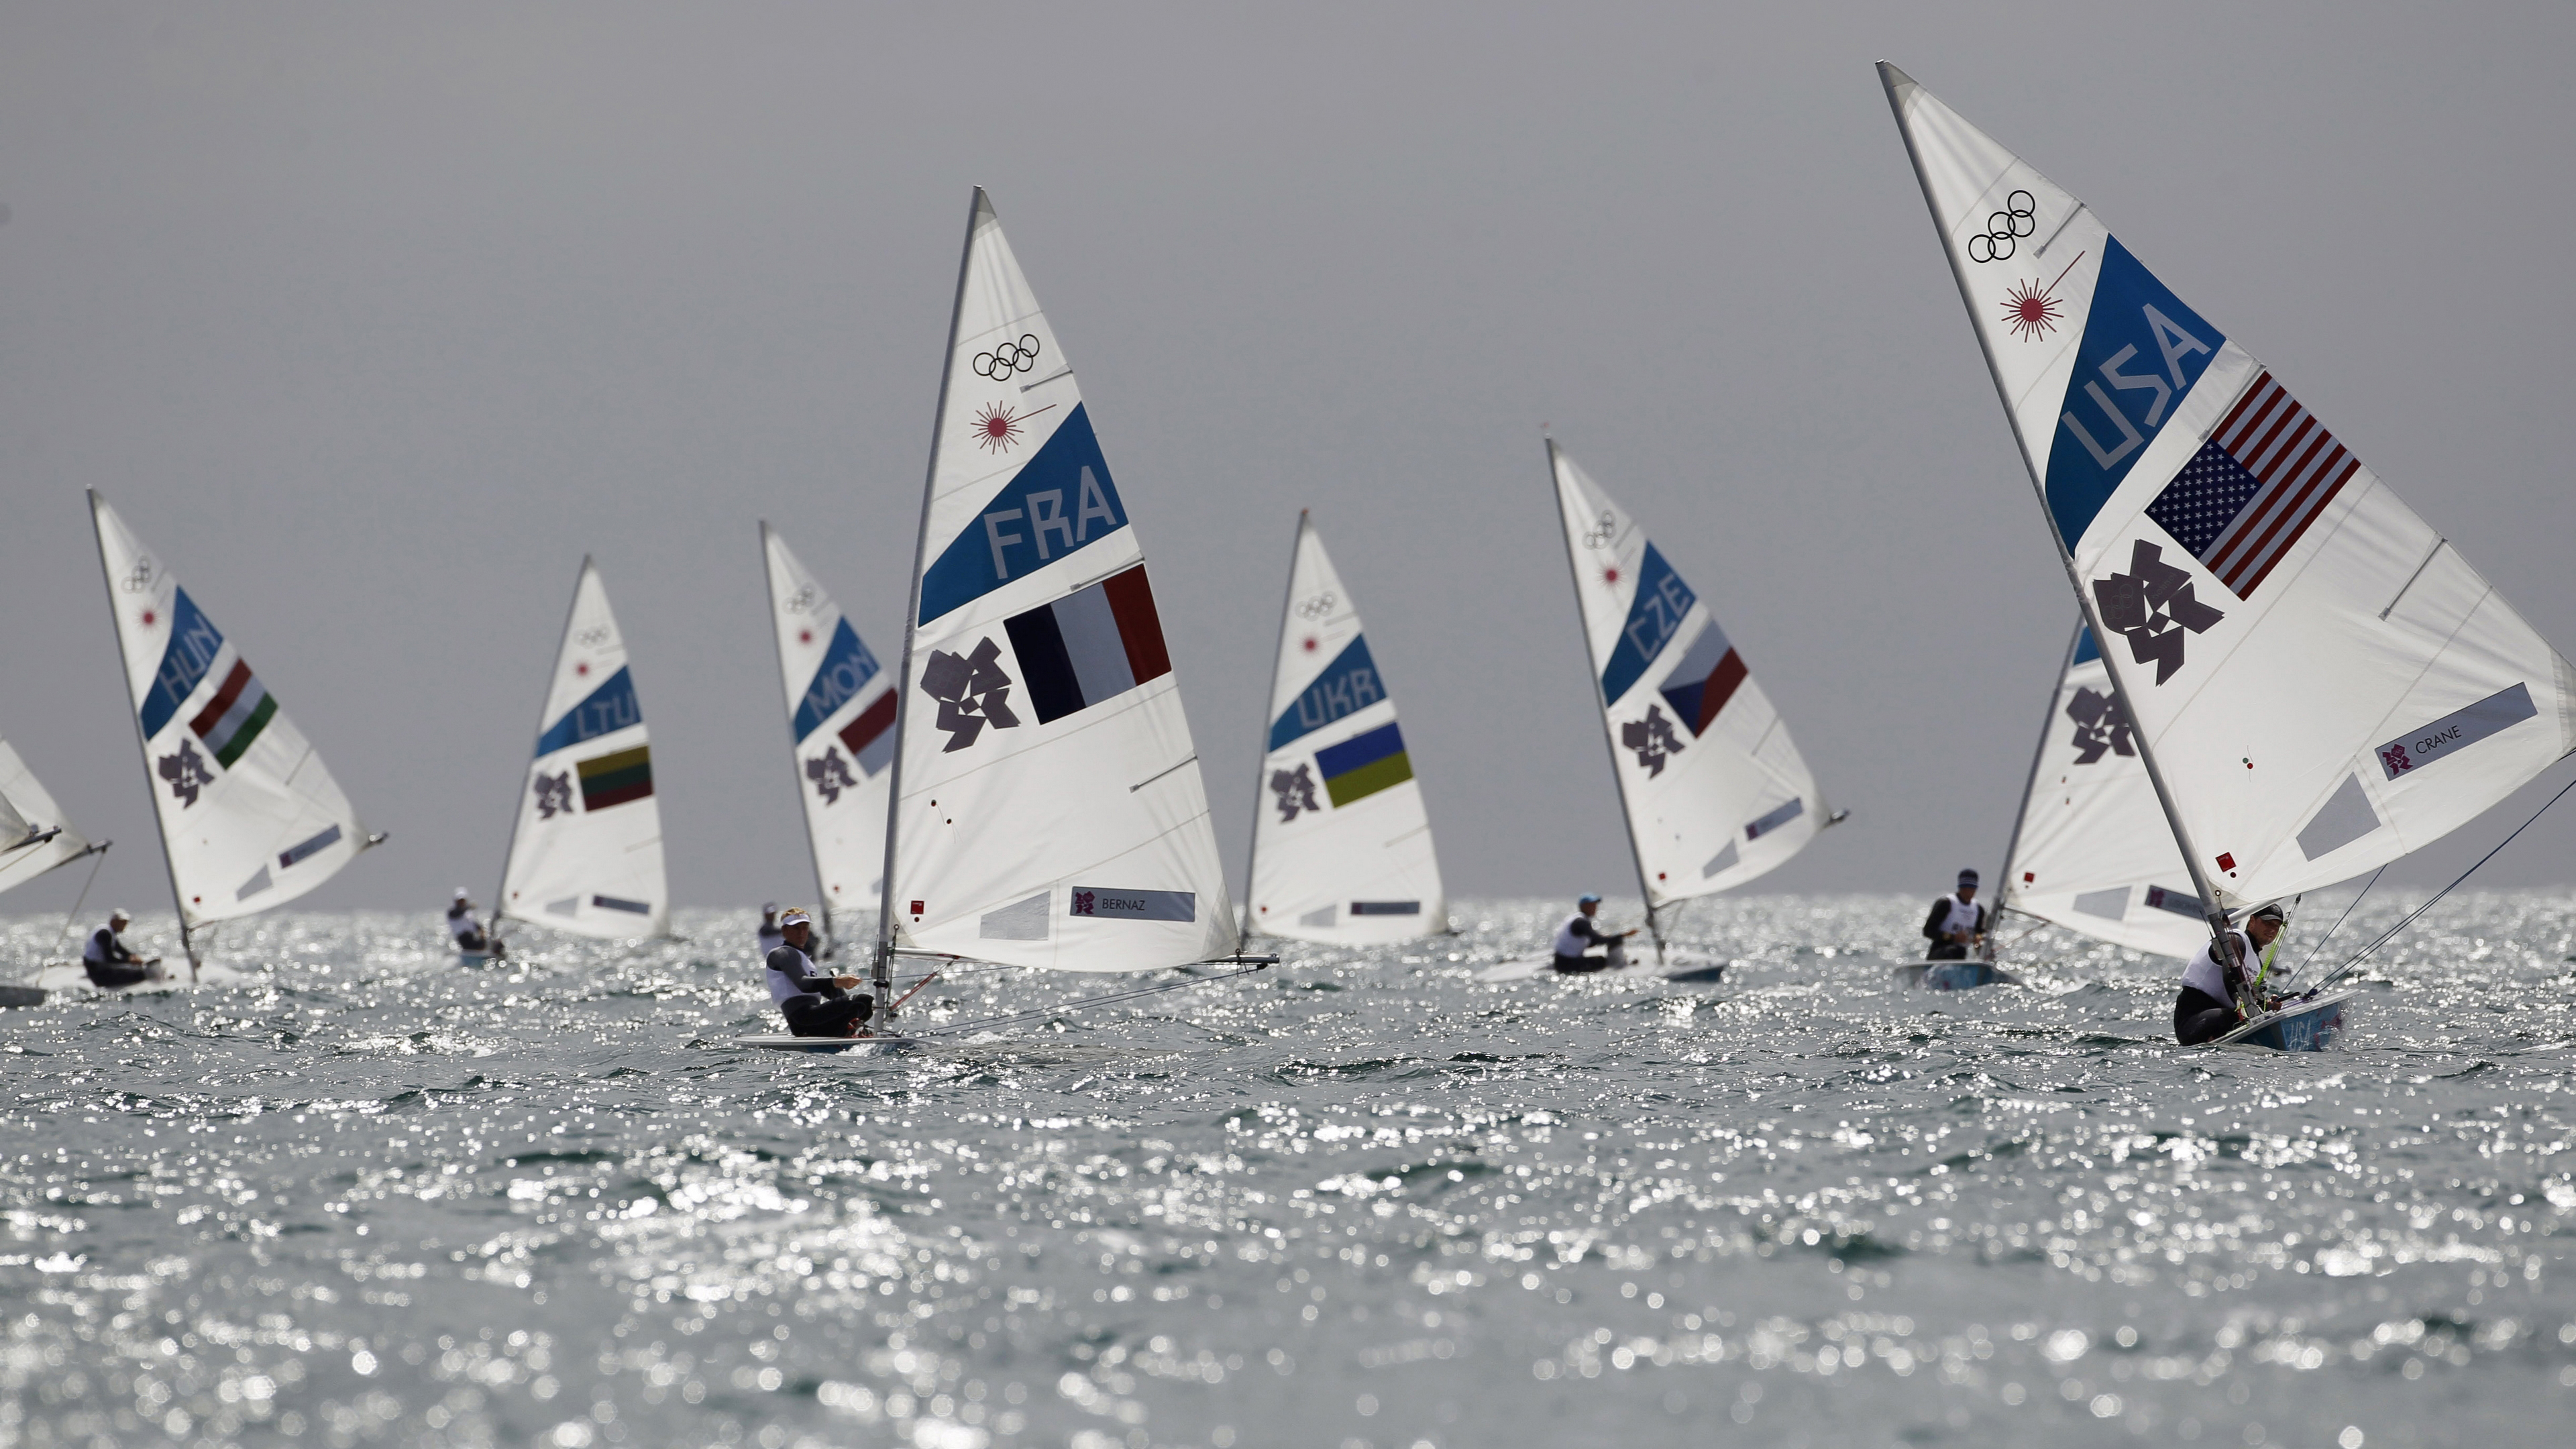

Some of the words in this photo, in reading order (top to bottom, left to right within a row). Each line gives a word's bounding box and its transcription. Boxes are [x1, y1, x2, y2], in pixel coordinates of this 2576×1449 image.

[2061, 303, 2210, 471] USA
[984, 465, 1117, 580] FRA
[1626, 574, 1690, 663] CZE
[160, 613, 219, 704] HUN
[807, 643, 875, 720] MON
[577, 690, 636, 740] LTU
[1297, 668, 1377, 729] UKR
[2415, 725, 2462, 754] CRANE
[1102, 898, 1144, 911] BERNAZ
